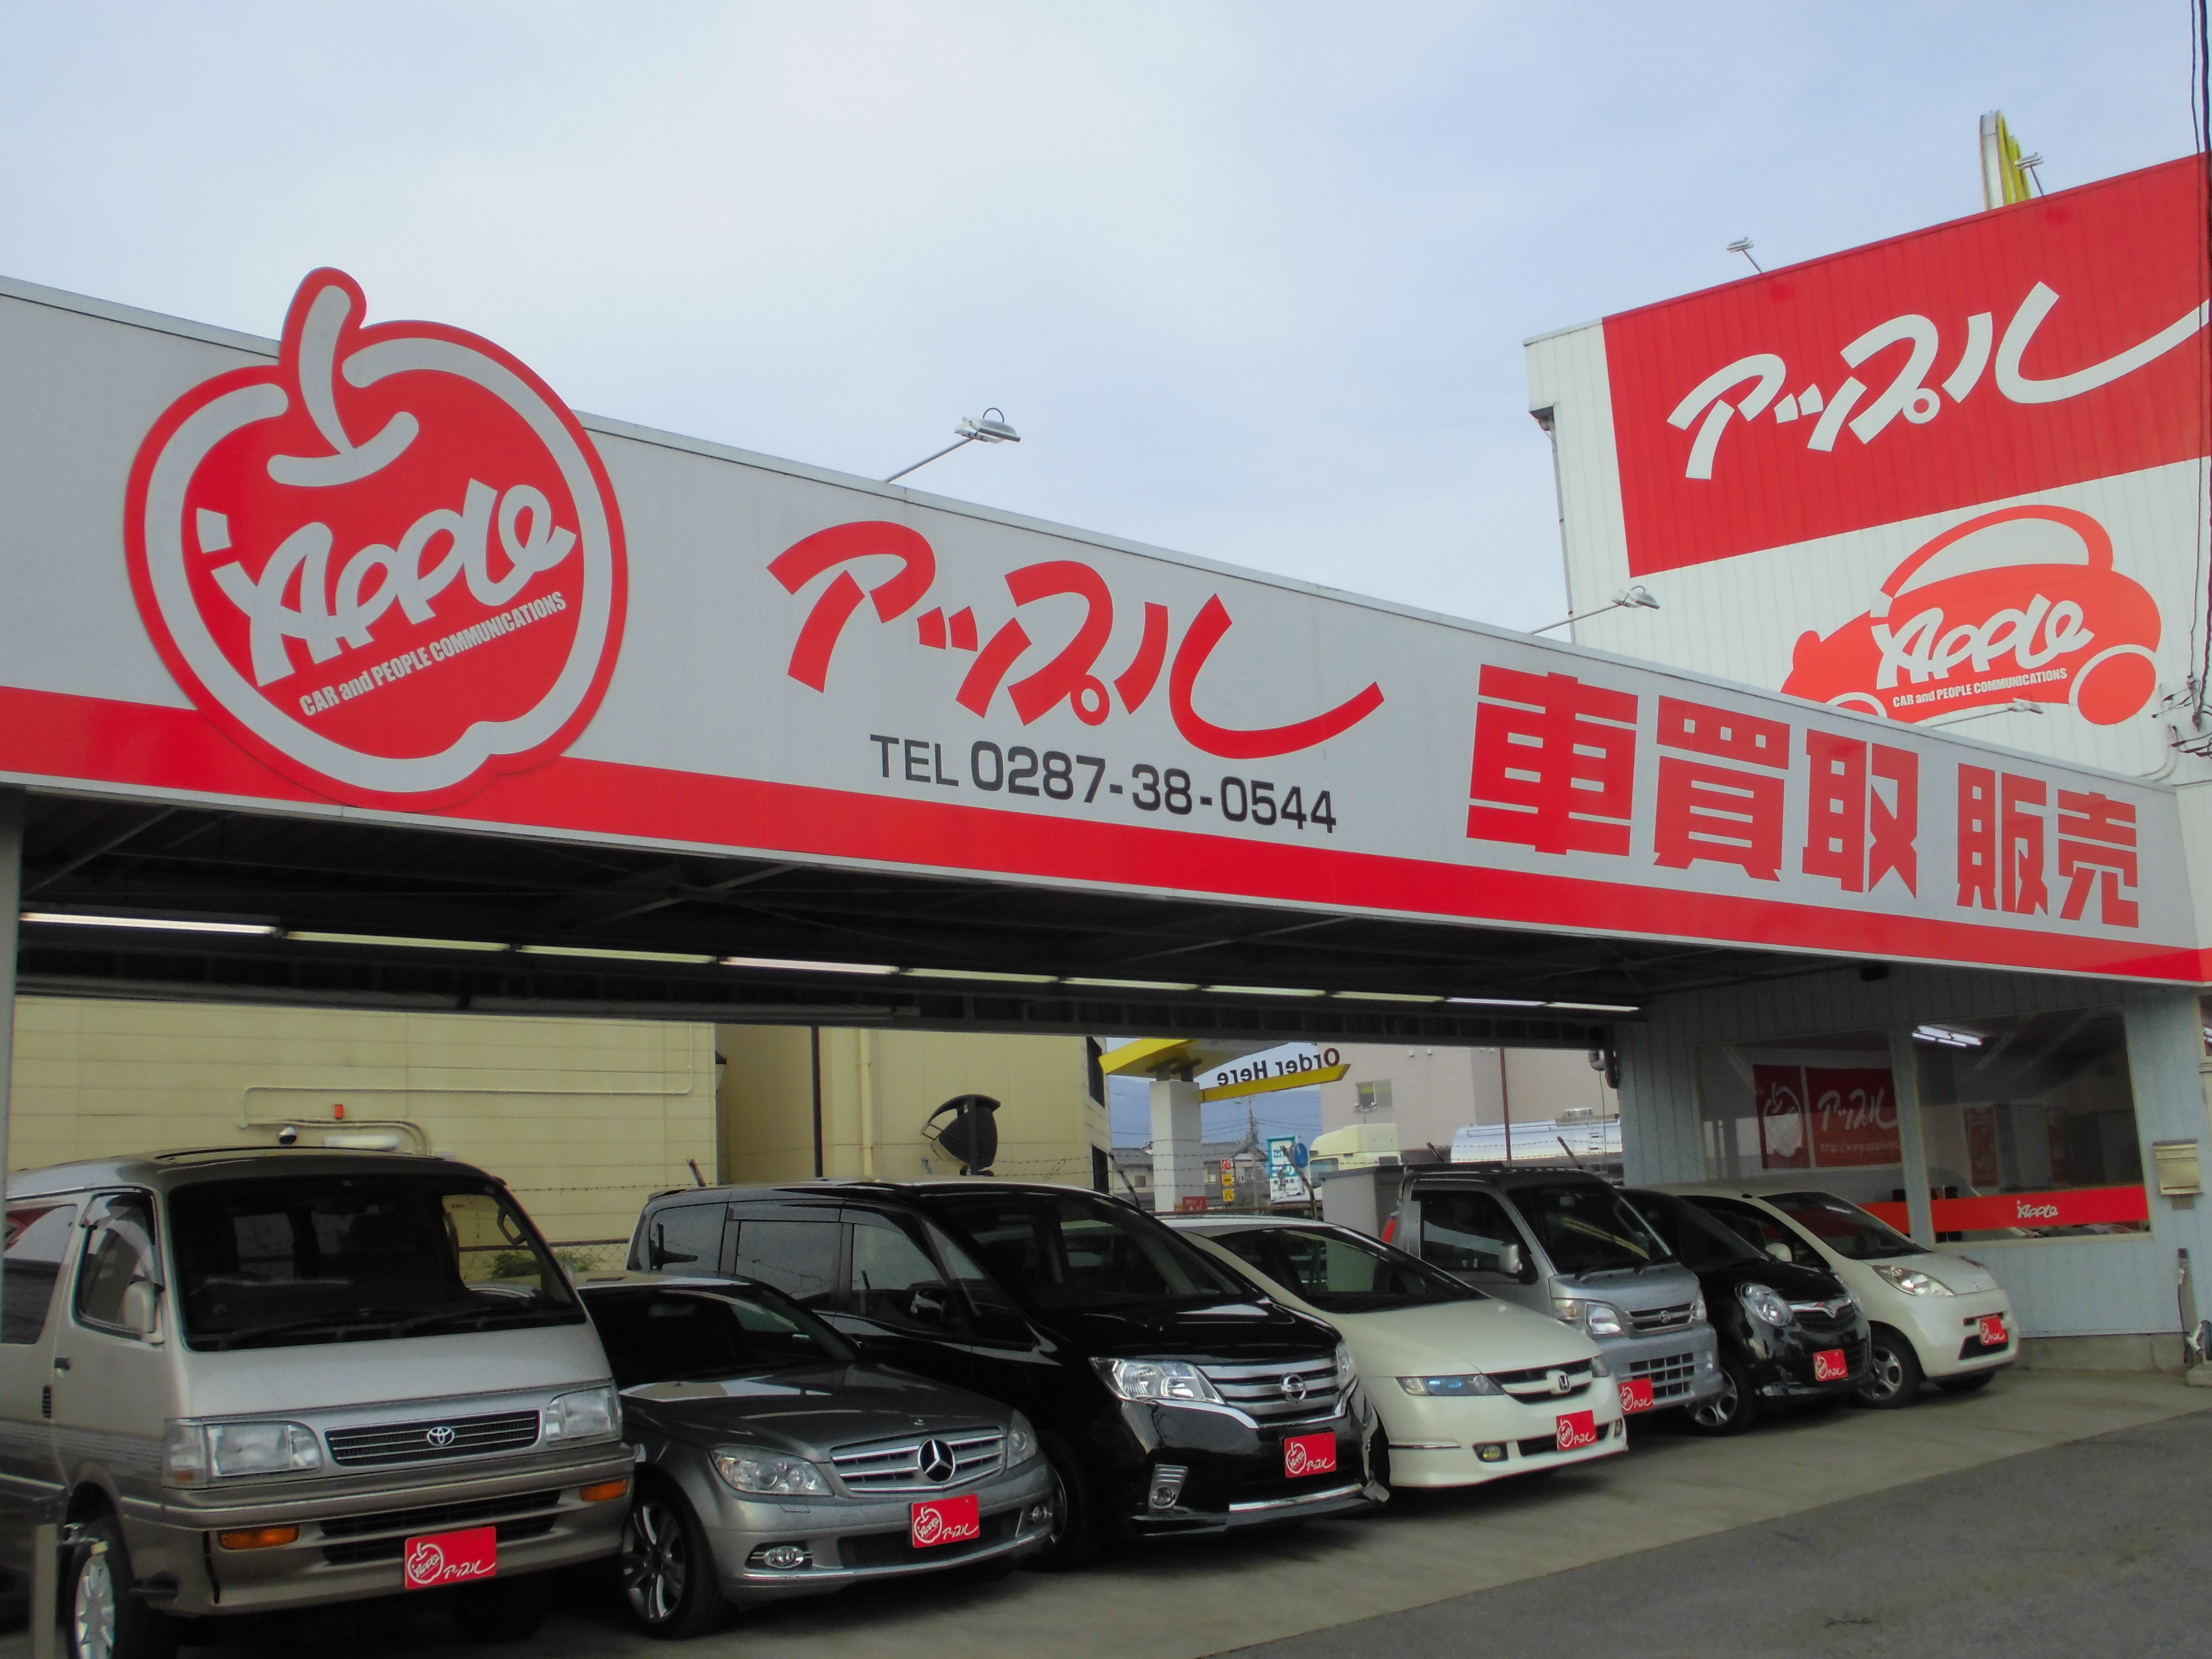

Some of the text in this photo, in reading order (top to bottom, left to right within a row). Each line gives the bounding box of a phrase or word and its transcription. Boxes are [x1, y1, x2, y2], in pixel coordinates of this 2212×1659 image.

[1667, 281, 2212, 479] アップル
[299, 591, 566, 716] CAR and PEOPLE COMMUNICATIONS
[767, 520, 1384, 759] アップル
[1893, 668, 2067, 708] CAR and PEOPLE COMMUNICATIONS
[870, 734, 1336, 834] TEL 0287-38-0544
[1466, 664, 2139, 928] 車買取 販売
[443, 1560, 496, 1579] アップル
